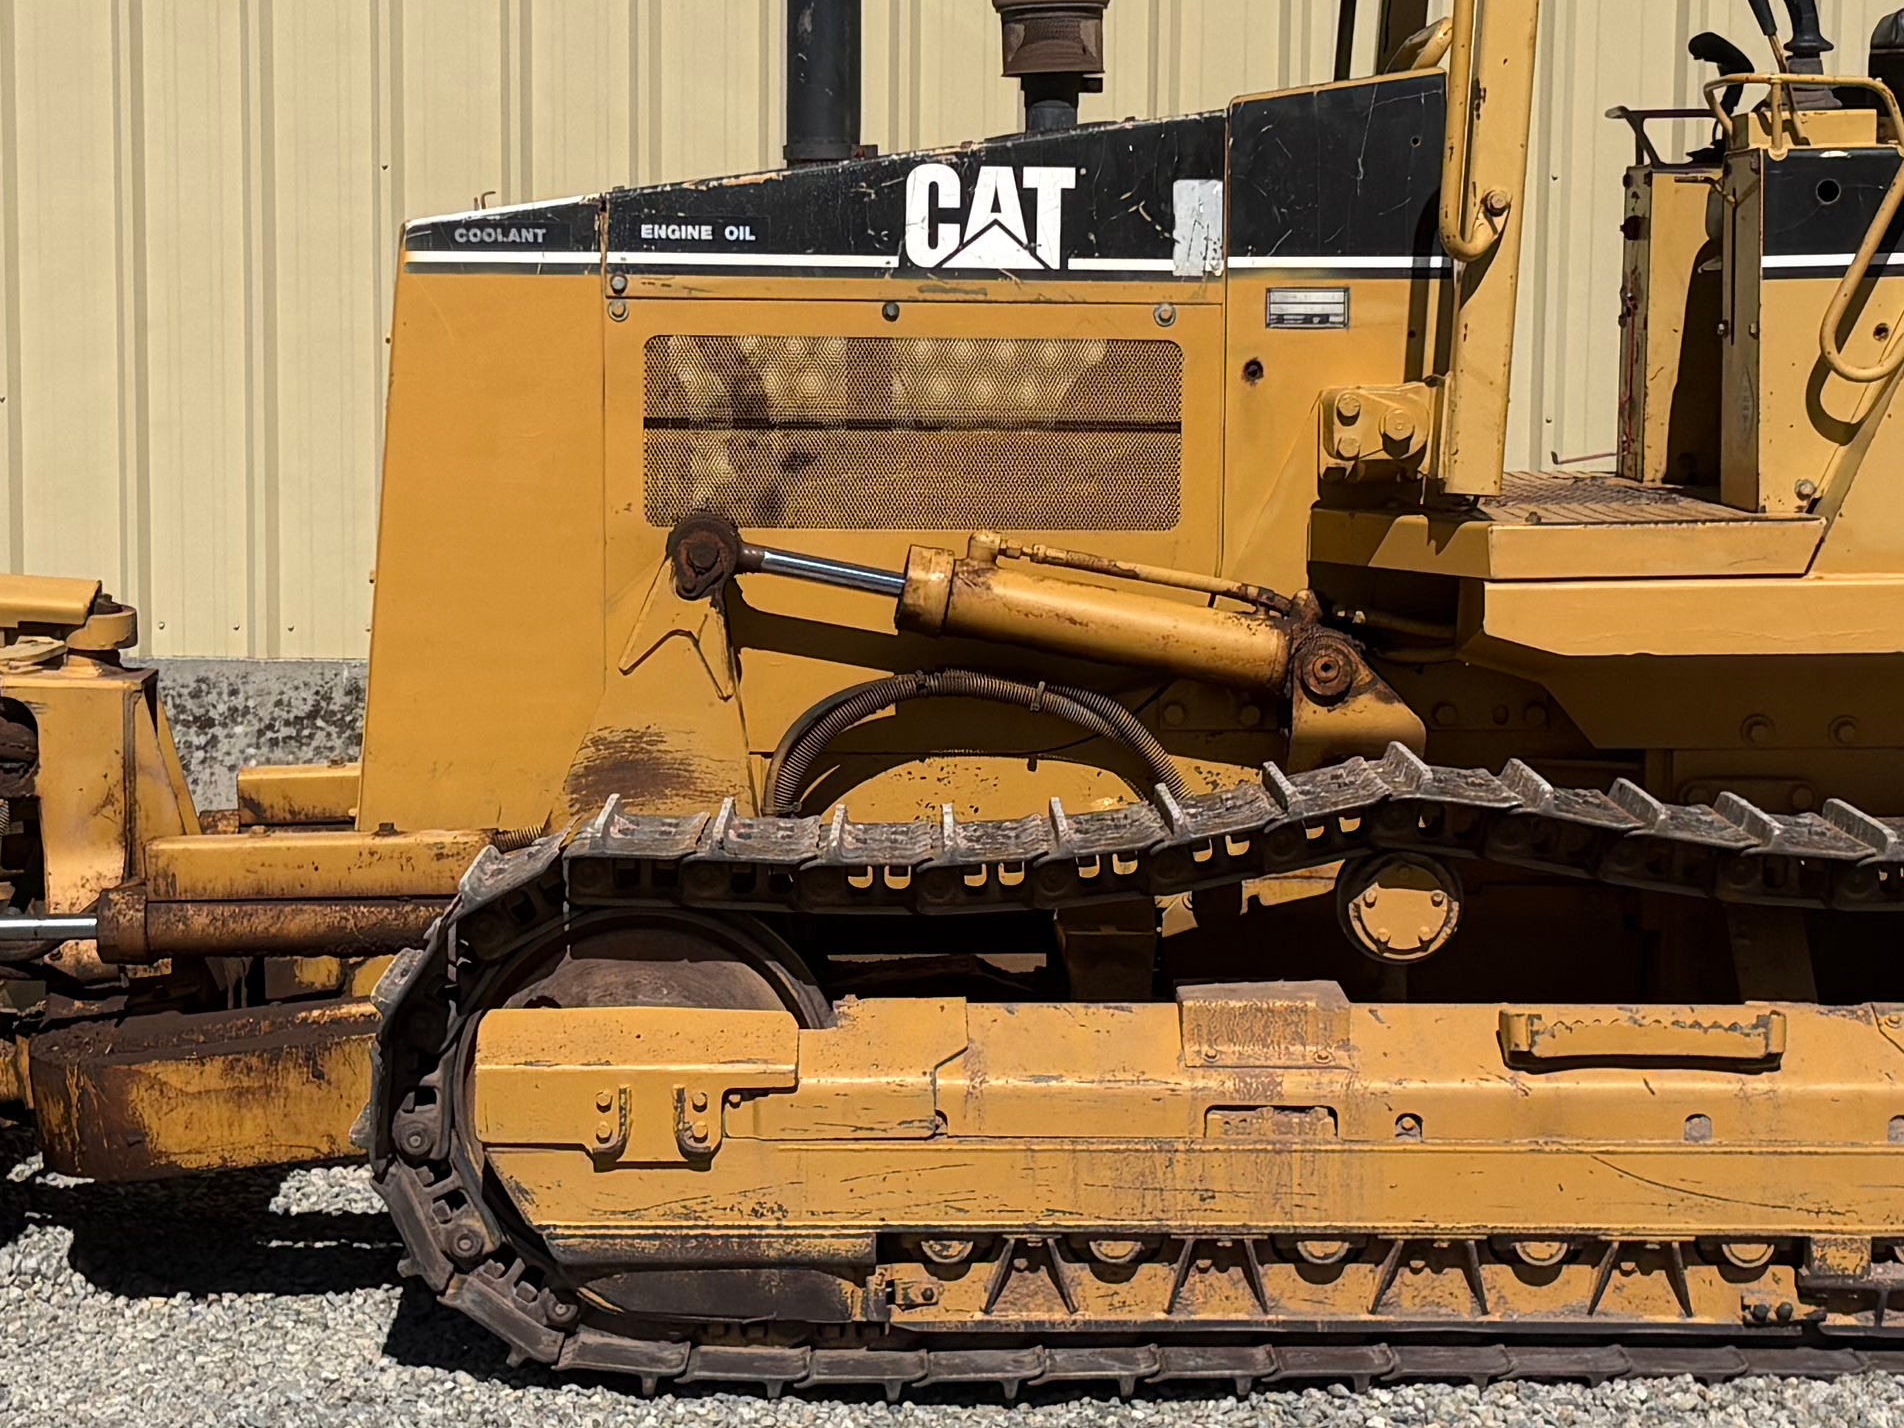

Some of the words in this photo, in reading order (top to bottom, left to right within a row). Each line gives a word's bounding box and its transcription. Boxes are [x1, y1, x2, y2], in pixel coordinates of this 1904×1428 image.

[905, 162, 1077, 270] CAT
[454, 227, 547, 243] COOLANT
[640, 223, 713, 241] ENGINE
[724, 224, 756, 242] OIL
